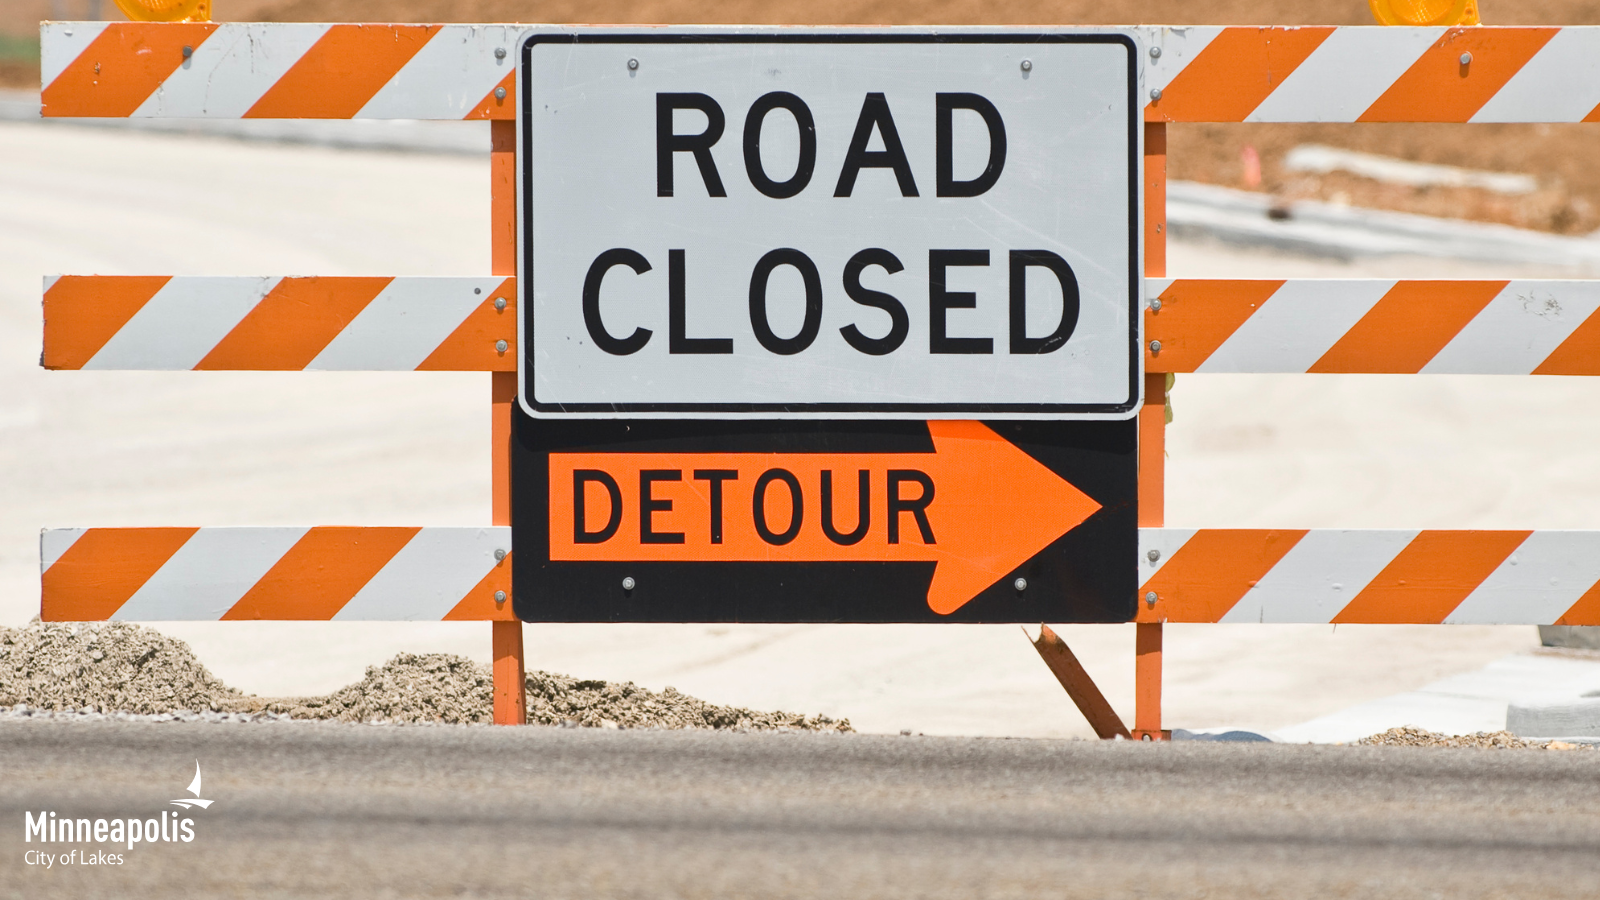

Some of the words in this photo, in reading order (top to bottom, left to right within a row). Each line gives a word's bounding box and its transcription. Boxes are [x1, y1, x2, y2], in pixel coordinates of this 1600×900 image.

[655, 91, 1008, 199] ROAD
[582, 247, 1081, 356] CLOSED
[573, 468, 937, 546] DETOUR
